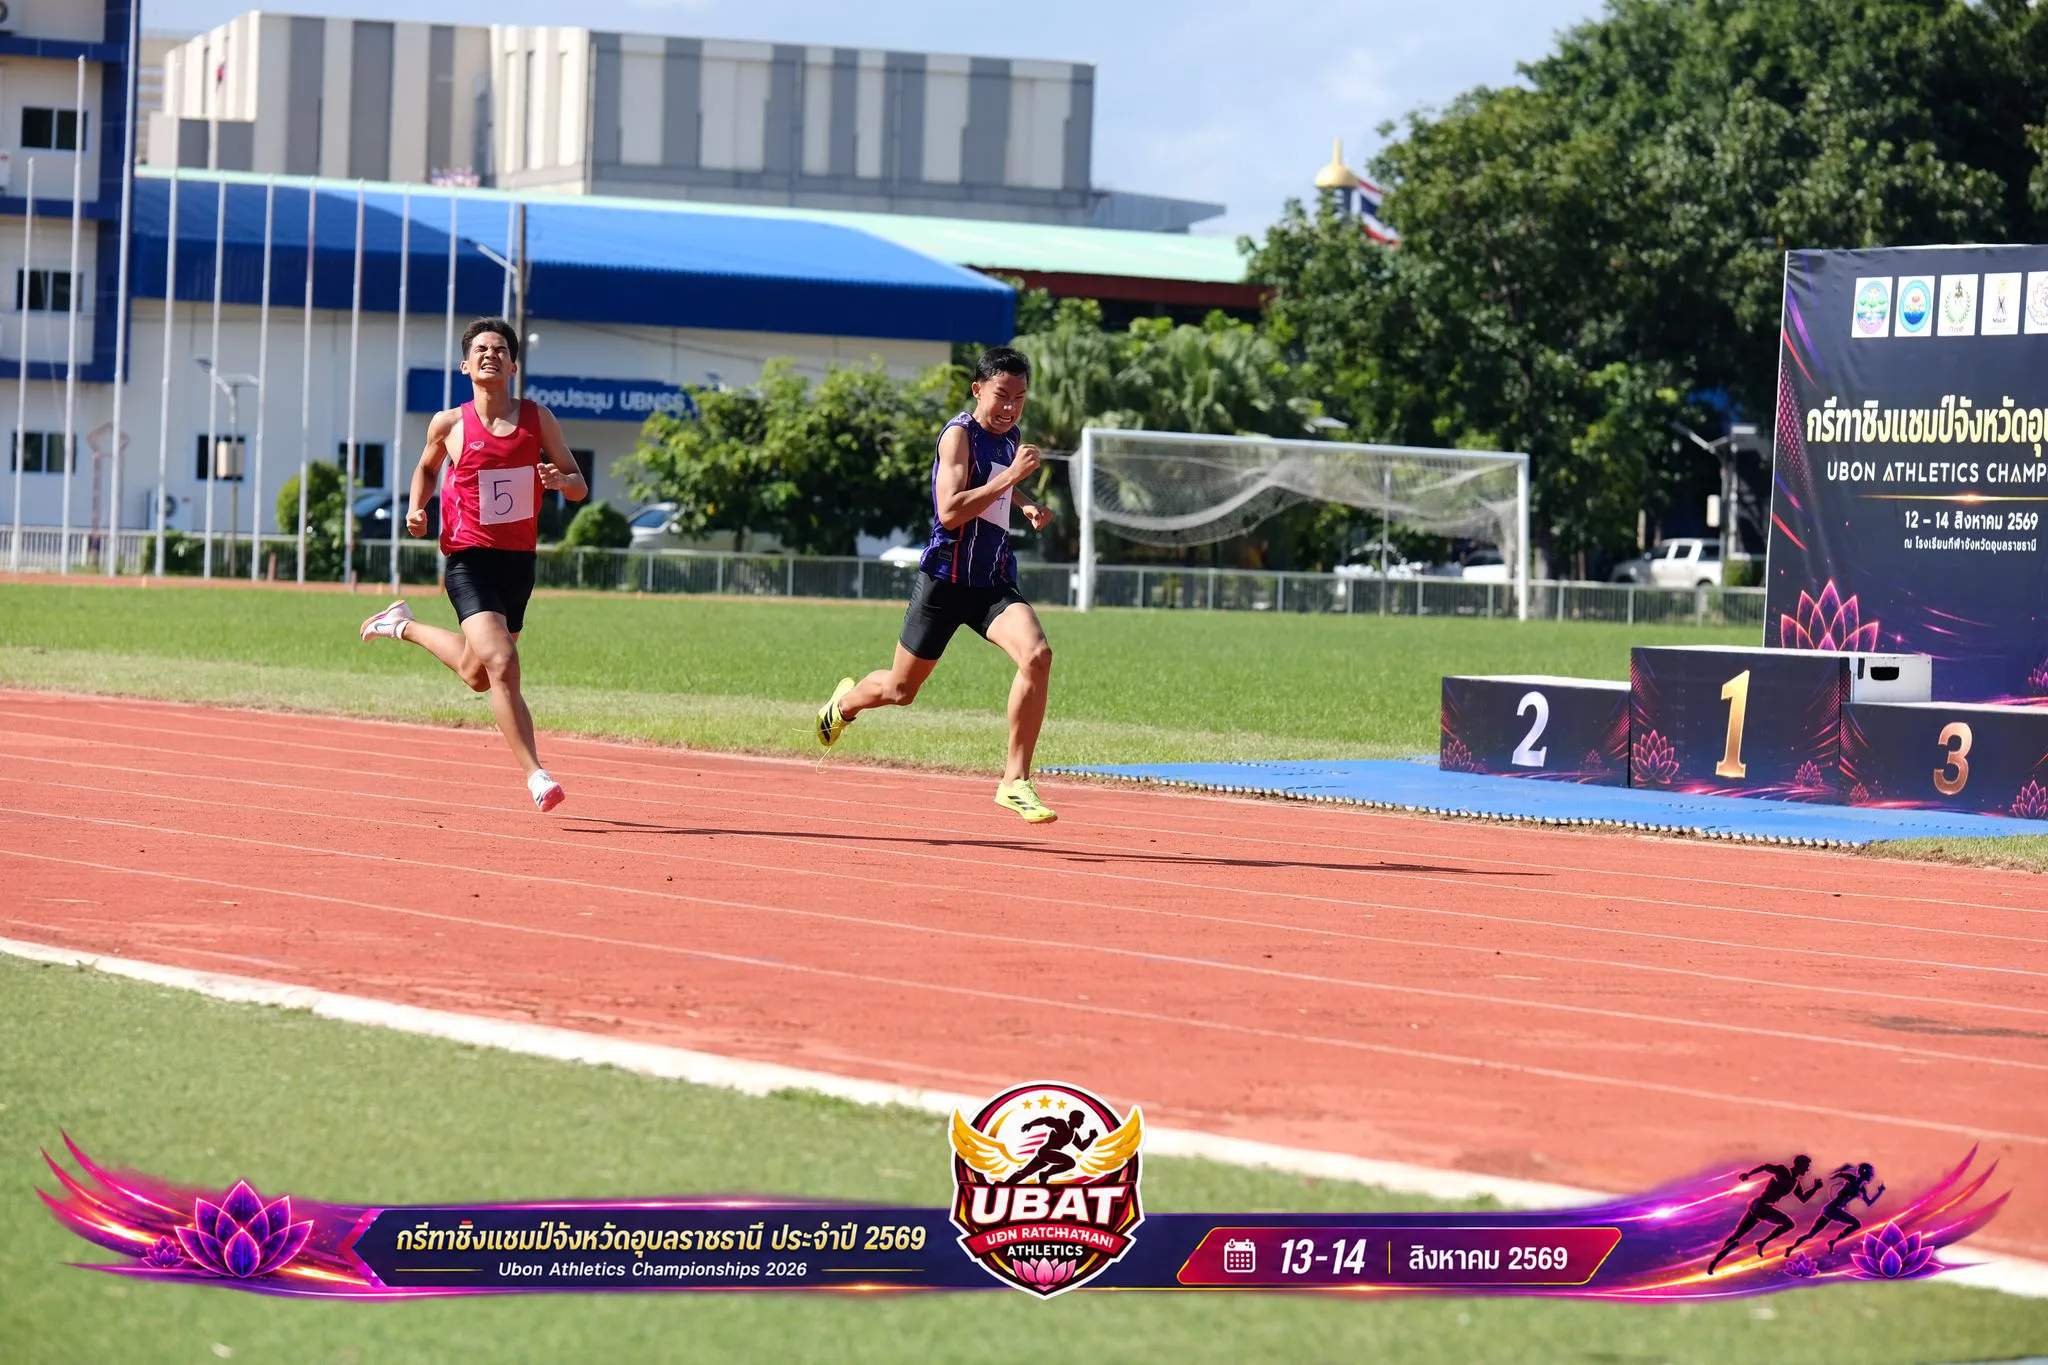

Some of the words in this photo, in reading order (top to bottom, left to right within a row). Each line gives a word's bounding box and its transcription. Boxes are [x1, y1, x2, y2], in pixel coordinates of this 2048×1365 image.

[1827, 461, 1876, 482] UBON
[1882, 461, 1979, 483] ATHLETICS
[1986, 462, 2048, 484] CHAMP
[493, 479, 514, 516] 5
[1905, 510, 1919, 529] 12
[1935, 511, 1949, 529] 14
[1954, 510, 2003, 530] สิงหาคม
[2007, 512, 2039, 531] 2569
[1904, 538, 1913, 549] ณ
[1510, 691, 1550, 768] 2
[1715, 669, 1751, 779] 1
[1933, 721, 1974, 797] 3
